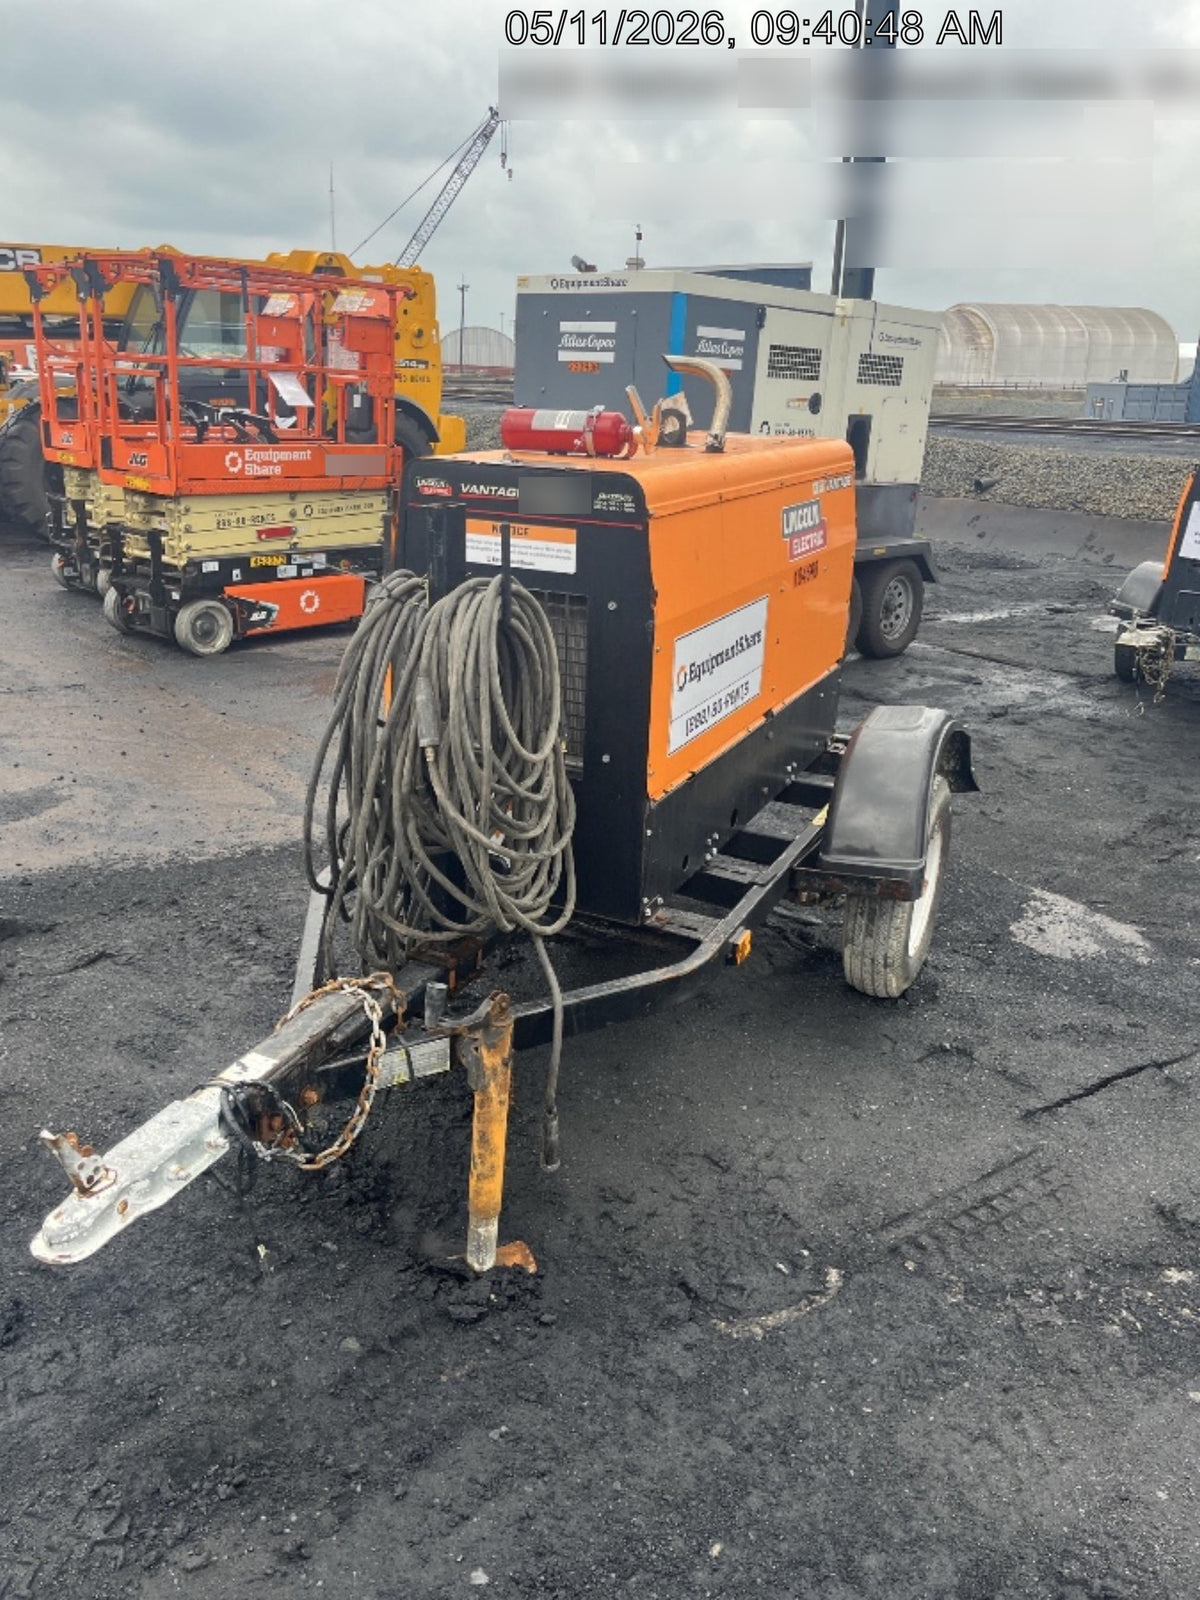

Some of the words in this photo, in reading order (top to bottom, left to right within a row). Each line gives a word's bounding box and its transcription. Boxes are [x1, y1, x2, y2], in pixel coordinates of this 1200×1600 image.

[0, 248, 41, 270] CB
[244, 449, 312, 462] Equipment
[244, 463, 282, 475] Share
[460, 483, 519, 498] VANTAG
[783, 504, 819, 535] LINCOLN
[792, 530, 824, 555] ELECTRIC
[688, 629, 763, 684] EquipmentShare
